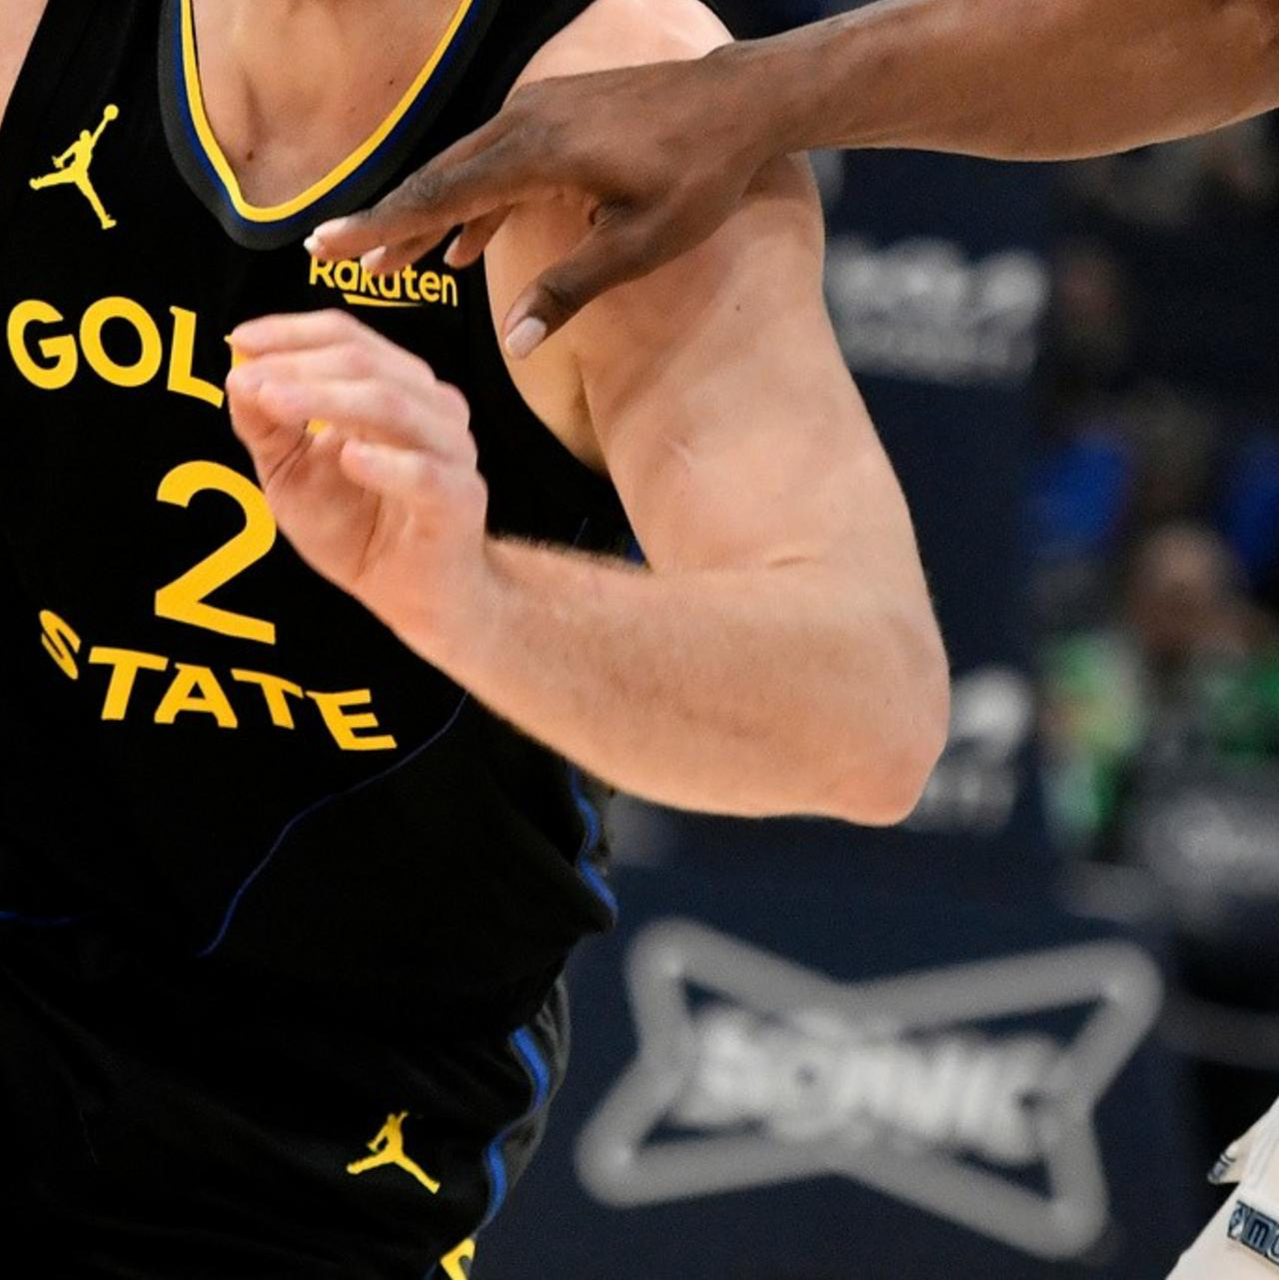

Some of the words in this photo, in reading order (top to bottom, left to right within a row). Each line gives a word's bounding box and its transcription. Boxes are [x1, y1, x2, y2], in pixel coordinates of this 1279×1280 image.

[309, 256, 458, 307] Rakuten
[7, 296, 248, 412] GOL
[154, 460, 277, 645] 2
[39, 609, 398, 751] STATE
